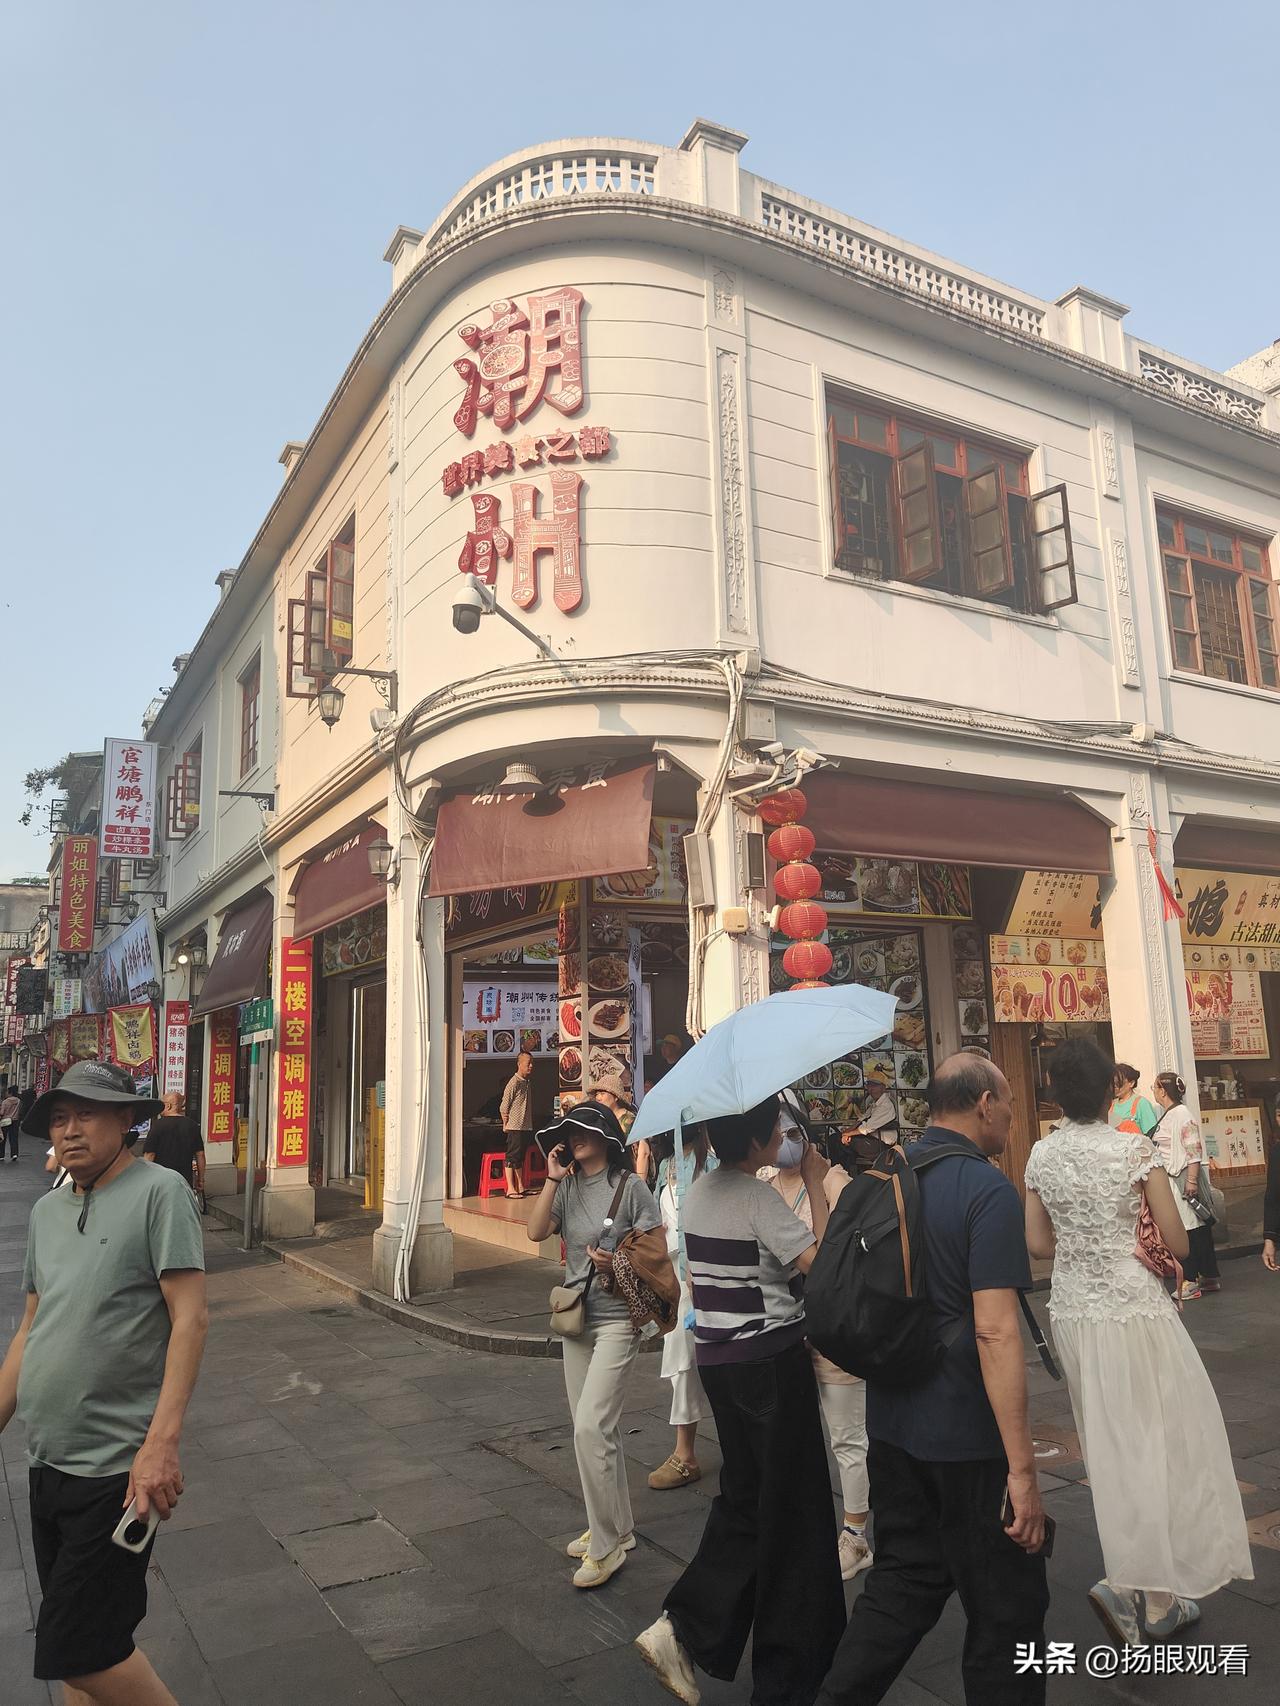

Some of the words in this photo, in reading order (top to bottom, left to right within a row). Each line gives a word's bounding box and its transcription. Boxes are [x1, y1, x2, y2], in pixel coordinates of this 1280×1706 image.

[441, 425, 611, 498] 世界美食之都
[115, 746, 145, 824] 官塘鹏祥
[112, 845, 143, 854] 牛丸汤
[65, 839, 90, 948] 丽姐特色美食
[1041, 967, 1079, 1020] 10
[168, 1041, 185, 1052] 猪丸
[168, 1055, 184, 1066] 猪肉
[281, 949, 308, 1158] 二楼空调雅座
